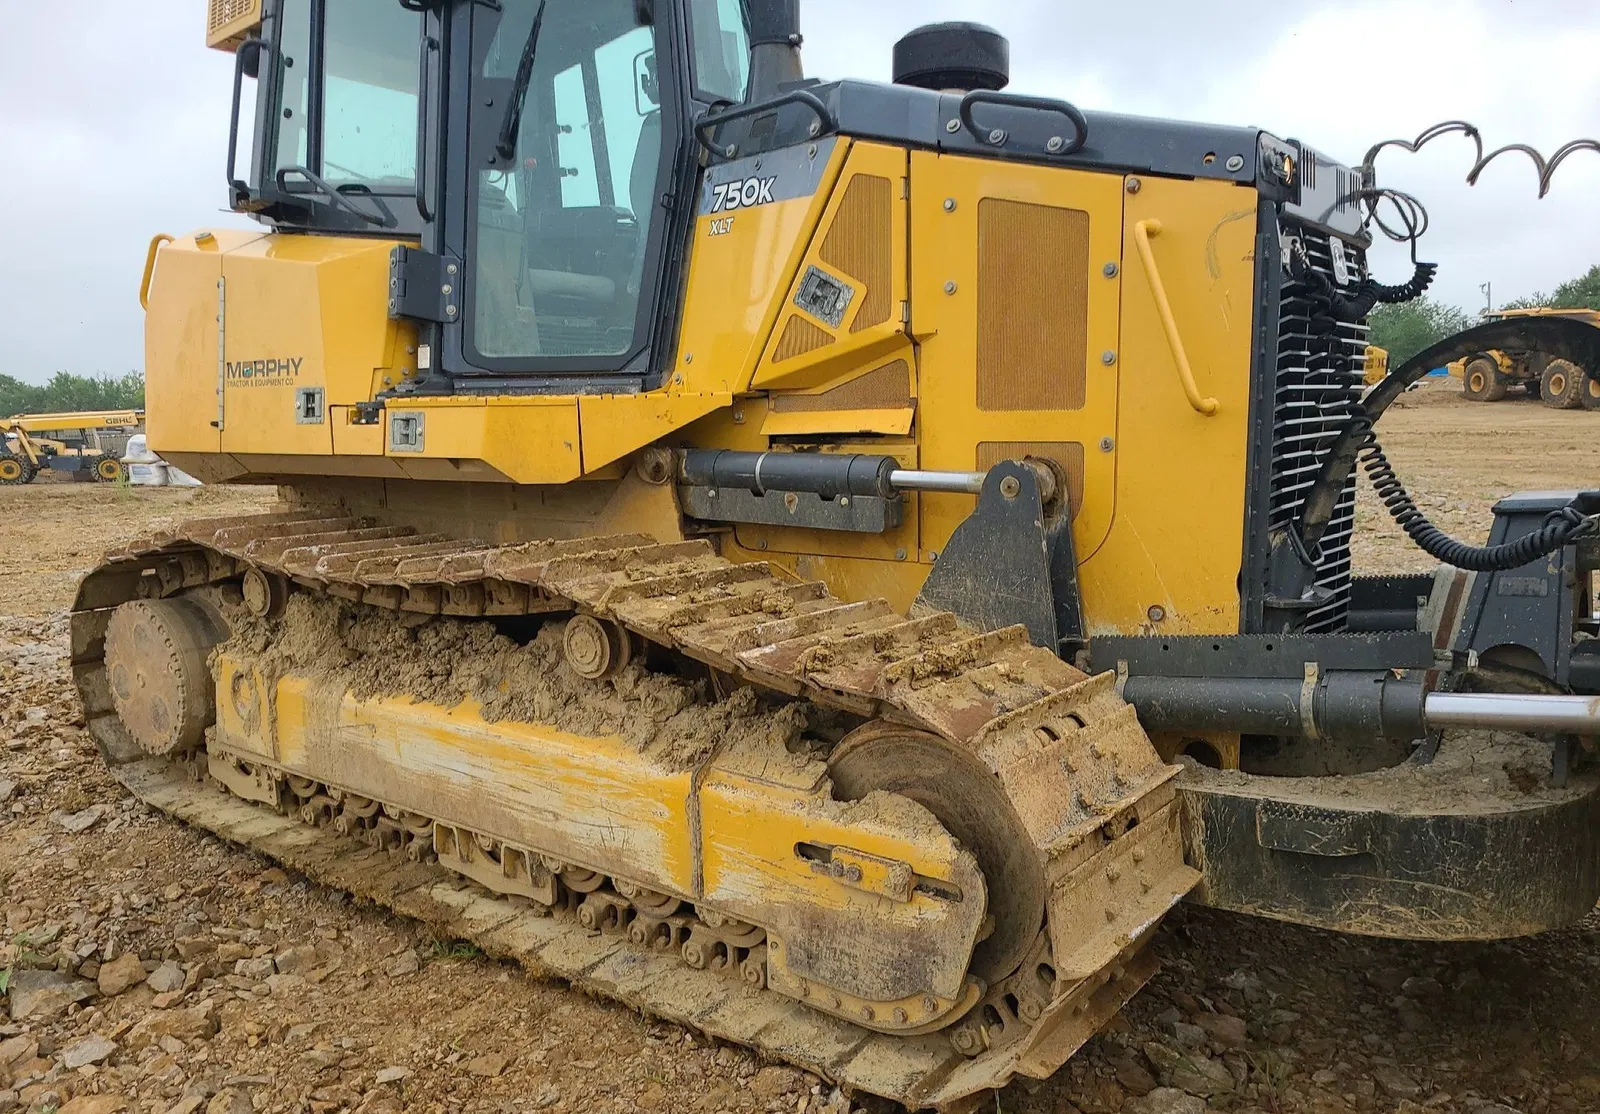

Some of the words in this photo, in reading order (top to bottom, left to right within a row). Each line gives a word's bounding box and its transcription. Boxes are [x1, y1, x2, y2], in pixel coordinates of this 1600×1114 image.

[711, 175, 778, 213] 750K
[708, 216, 735, 236] XLT
[227, 379, 249, 388] TRACTOR
[254, 378, 284, 387] EQUIPMENT
[105, 416, 132, 424] GEHL
